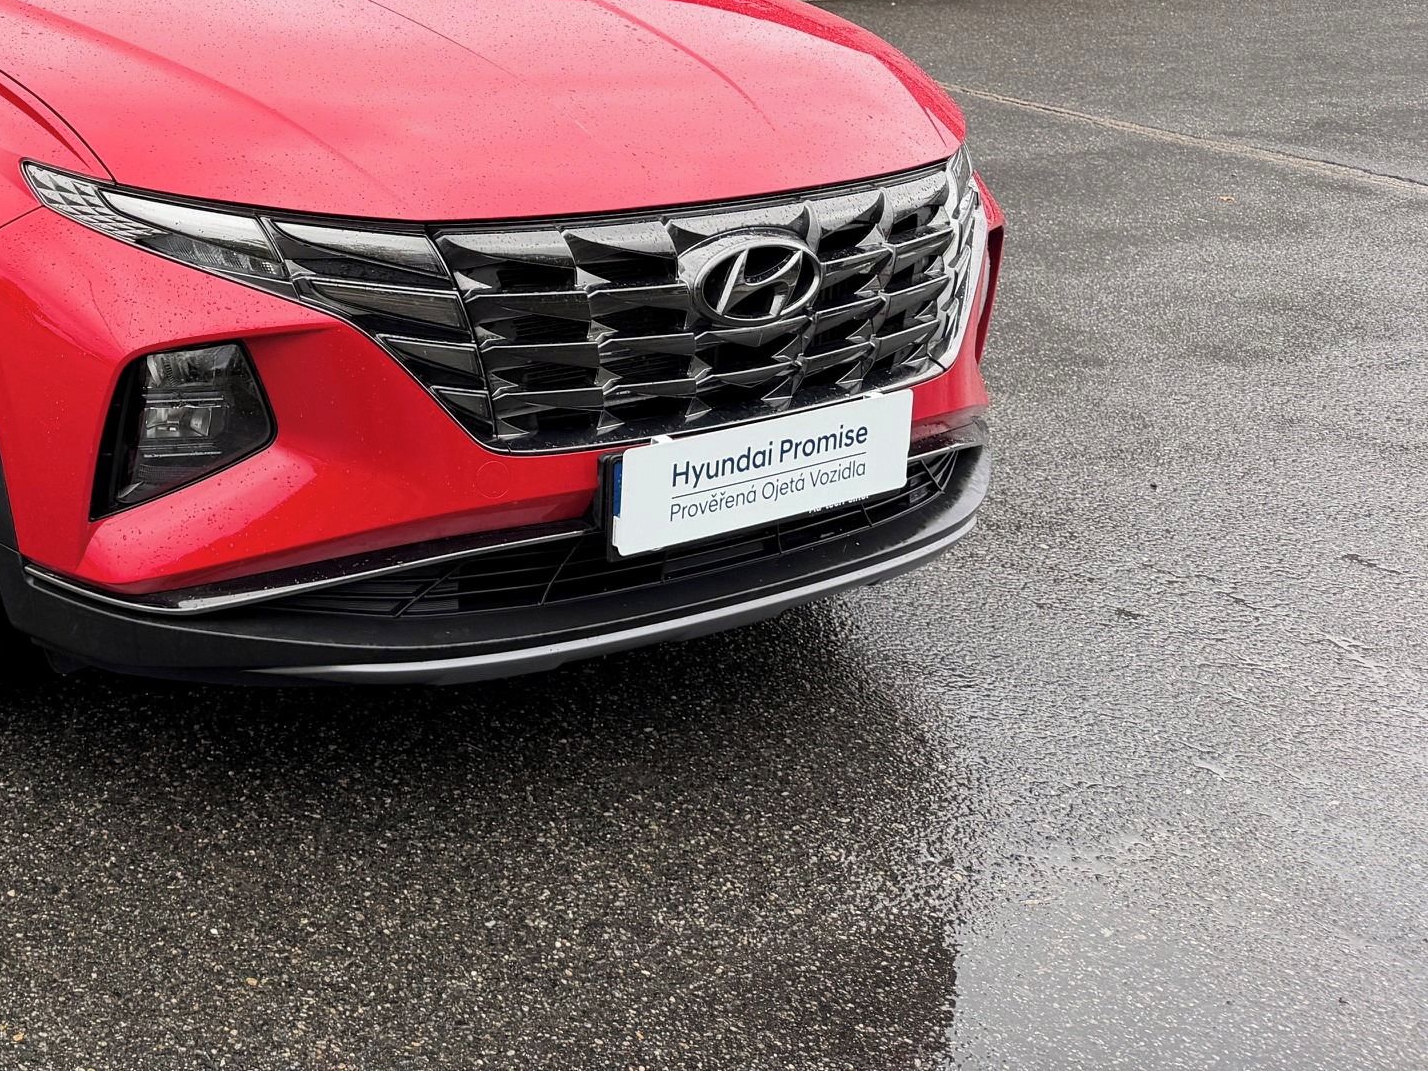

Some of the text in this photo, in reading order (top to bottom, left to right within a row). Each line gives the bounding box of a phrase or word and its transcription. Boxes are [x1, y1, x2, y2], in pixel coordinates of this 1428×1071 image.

[671, 424, 868, 489] Hyundai Promise
[669, 461, 866, 522] Prověřená Ojetá Vozidla
